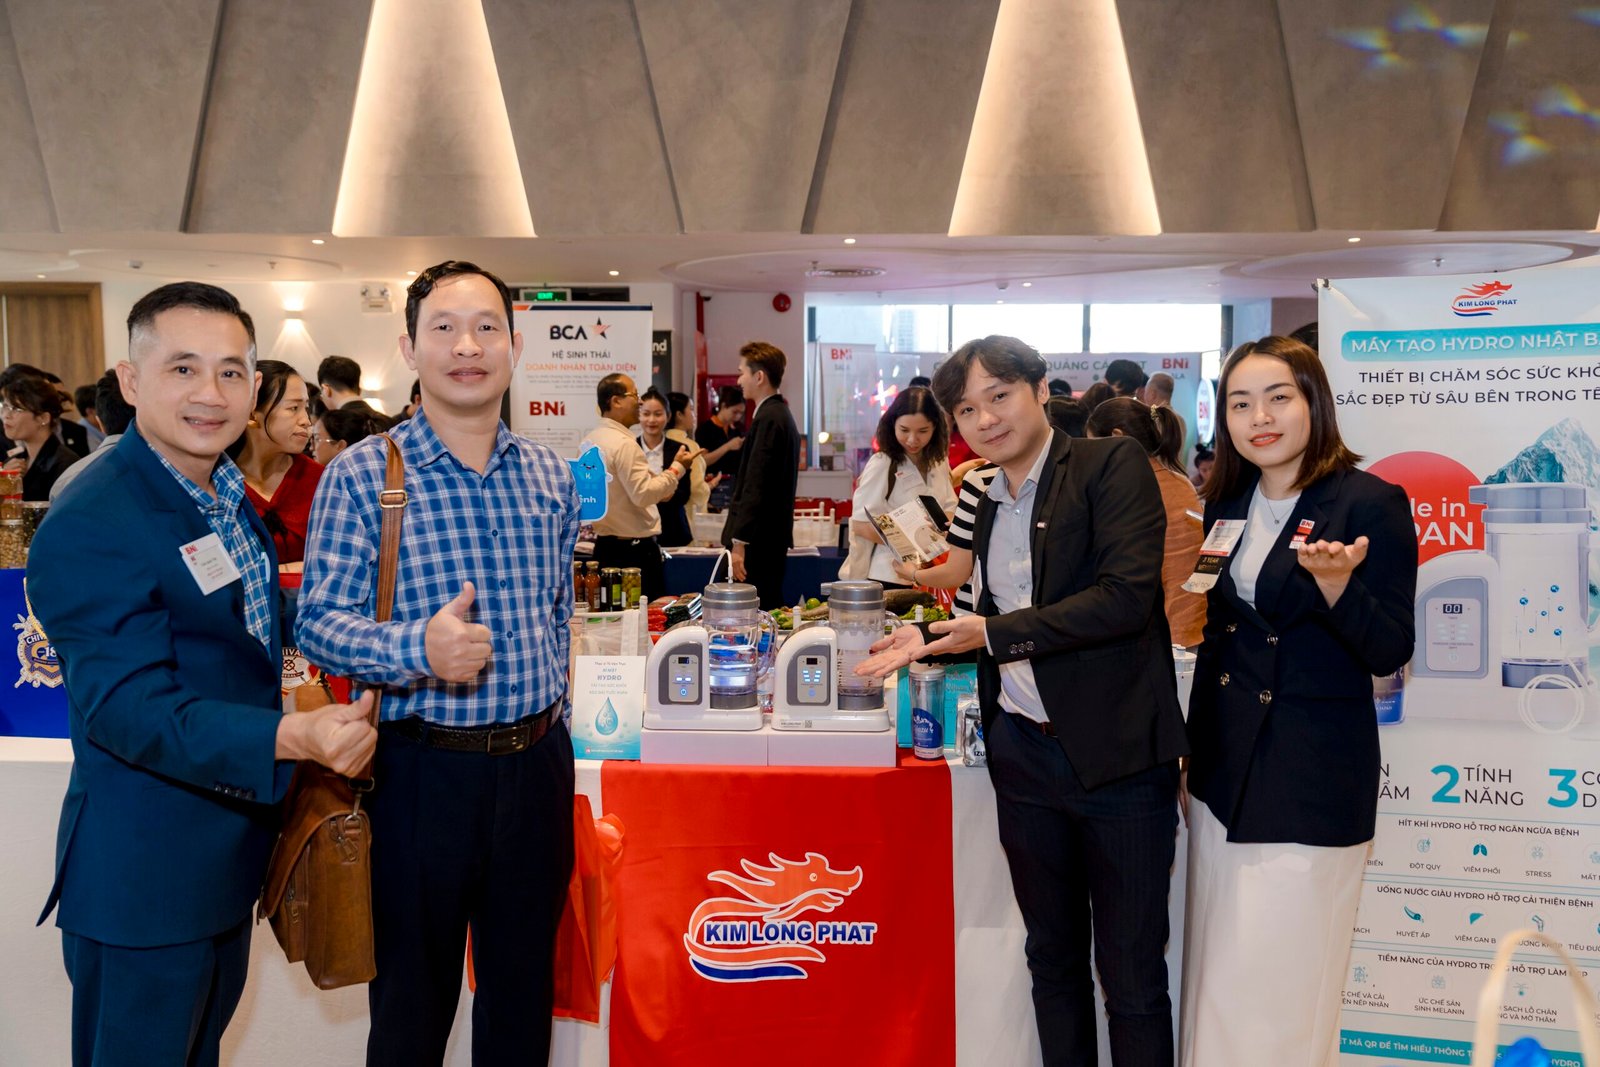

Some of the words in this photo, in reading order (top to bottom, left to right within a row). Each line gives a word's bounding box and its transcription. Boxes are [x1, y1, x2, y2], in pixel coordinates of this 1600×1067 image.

[550, 325, 588, 340] BCA
[653, 338, 668, 352] nd
[1352, 336, 1391, 352] MÁY
[1396, 339, 1436, 356] TẠO
[1442, 336, 1514, 351] HYDRO
[1521, 330, 1578, 350] NHẬT
[1584, 332, 1600, 346] B
[552, 350, 563, 360] HỆ
[590, 350, 611, 358] THÁI
[560, 362, 586, 371] NHÂN
[589, 362, 613, 371] TOÀN
[616, 362, 637, 372] DIỆN
[1092, 357, 1108, 370] CÁ
[1358, 368, 1404, 383] THIẾT
[1409, 372, 1424, 385] BỊ
[1430, 368, 1480, 382] CHĂM
[1486, 366, 1520, 380] SÓC
[1526, 365, 1561, 380] SỨC
[1336, 390, 1367, 405] SẮC
[1372, 394, 1405, 408] ĐẸP
[1410, 391, 1431, 404] TỪ
[1436, 390, 1468, 404] SÂU
[1476, 389, 1509, 403] BÊN
[1515, 390, 1576, 402] TRONG
[1442, 496, 1466, 518] in
[1464, 764, 1512, 783] TÍNH
[1378, 780, 1410, 800] ẨM
[1430, 764, 1460, 804] 2
[1548, 768, 1578, 808] 3
[1464, 786, 1524, 806] NĂNG
[1583, 793, 1598, 808] D
[1398, 818, 1412, 827] HÍT
[1414, 820, 1428, 828] KHÍ
[1430, 822, 1462, 830] HYDRO
[1464, 822, 1477, 830] HỖ
[1480, 824, 1497, 832] TRỢ
[1498, 825, 1524, 834] NGĂN
[1526, 826, 1552, 835] NGỪA
[1554, 828, 1580, 837] BỆNH
[1410, 862, 1424, 870] ĐỘT
[1526, 870, 1552, 878] STRESS
[1377, 885, 1402, 894] UỐNG
[1404, 888, 1429, 896] NƯỚC
[1431, 890, 1452, 898] GIÀU
[1454, 892, 1485, 900] HYDRO
[1487, 892, 1500, 901] HỖ
[1502, 895, 1520, 903] TRỢ
[1522, 896, 1537, 904] CẢI
[1540, 897, 1566, 906] THIỆN
[1568, 899, 1594, 908] BỆNH
[706, 924, 746, 942] KIM
[752, 924, 812, 942] LONG
[818, 924, 876, 942] PHAT
[1396, 930, 1418, 938] HUYẾT
[1474, 936, 1490, 944] GAN
[1516, 940, 1540, 948] ƯƠNG
[1400, 956, 1424, 965] NĂNG
[1426, 956, 1444, 966] CỦA
[1446, 960, 1478, 969] HYDRO
[1512, 964, 1526, 973] HỖ
[1528, 966, 1546, 975] TRỢ
[1548, 968, 1567, 976] LÀM
[1346, 990, 1360, 998] CHẾ
[1352, 998, 1368, 1006] NẾP
[1430, 998, 1445, 1006] CHẾ
[1432, 1007, 1465, 1015] MELANIN
[1536, 1008, 1558, 1016] CHÂN
[1364, 1040, 1378, 1049] QR
[1379, 1040, 1392, 1050] ĐỂ
[1394, 1042, 1408, 1052] TÌM
[1410, 1044, 1432, 1054] HIỂU
[1434, 1046, 1466, 1057] THÔNG
[1552, 1058, 1580, 1067] YDRO
